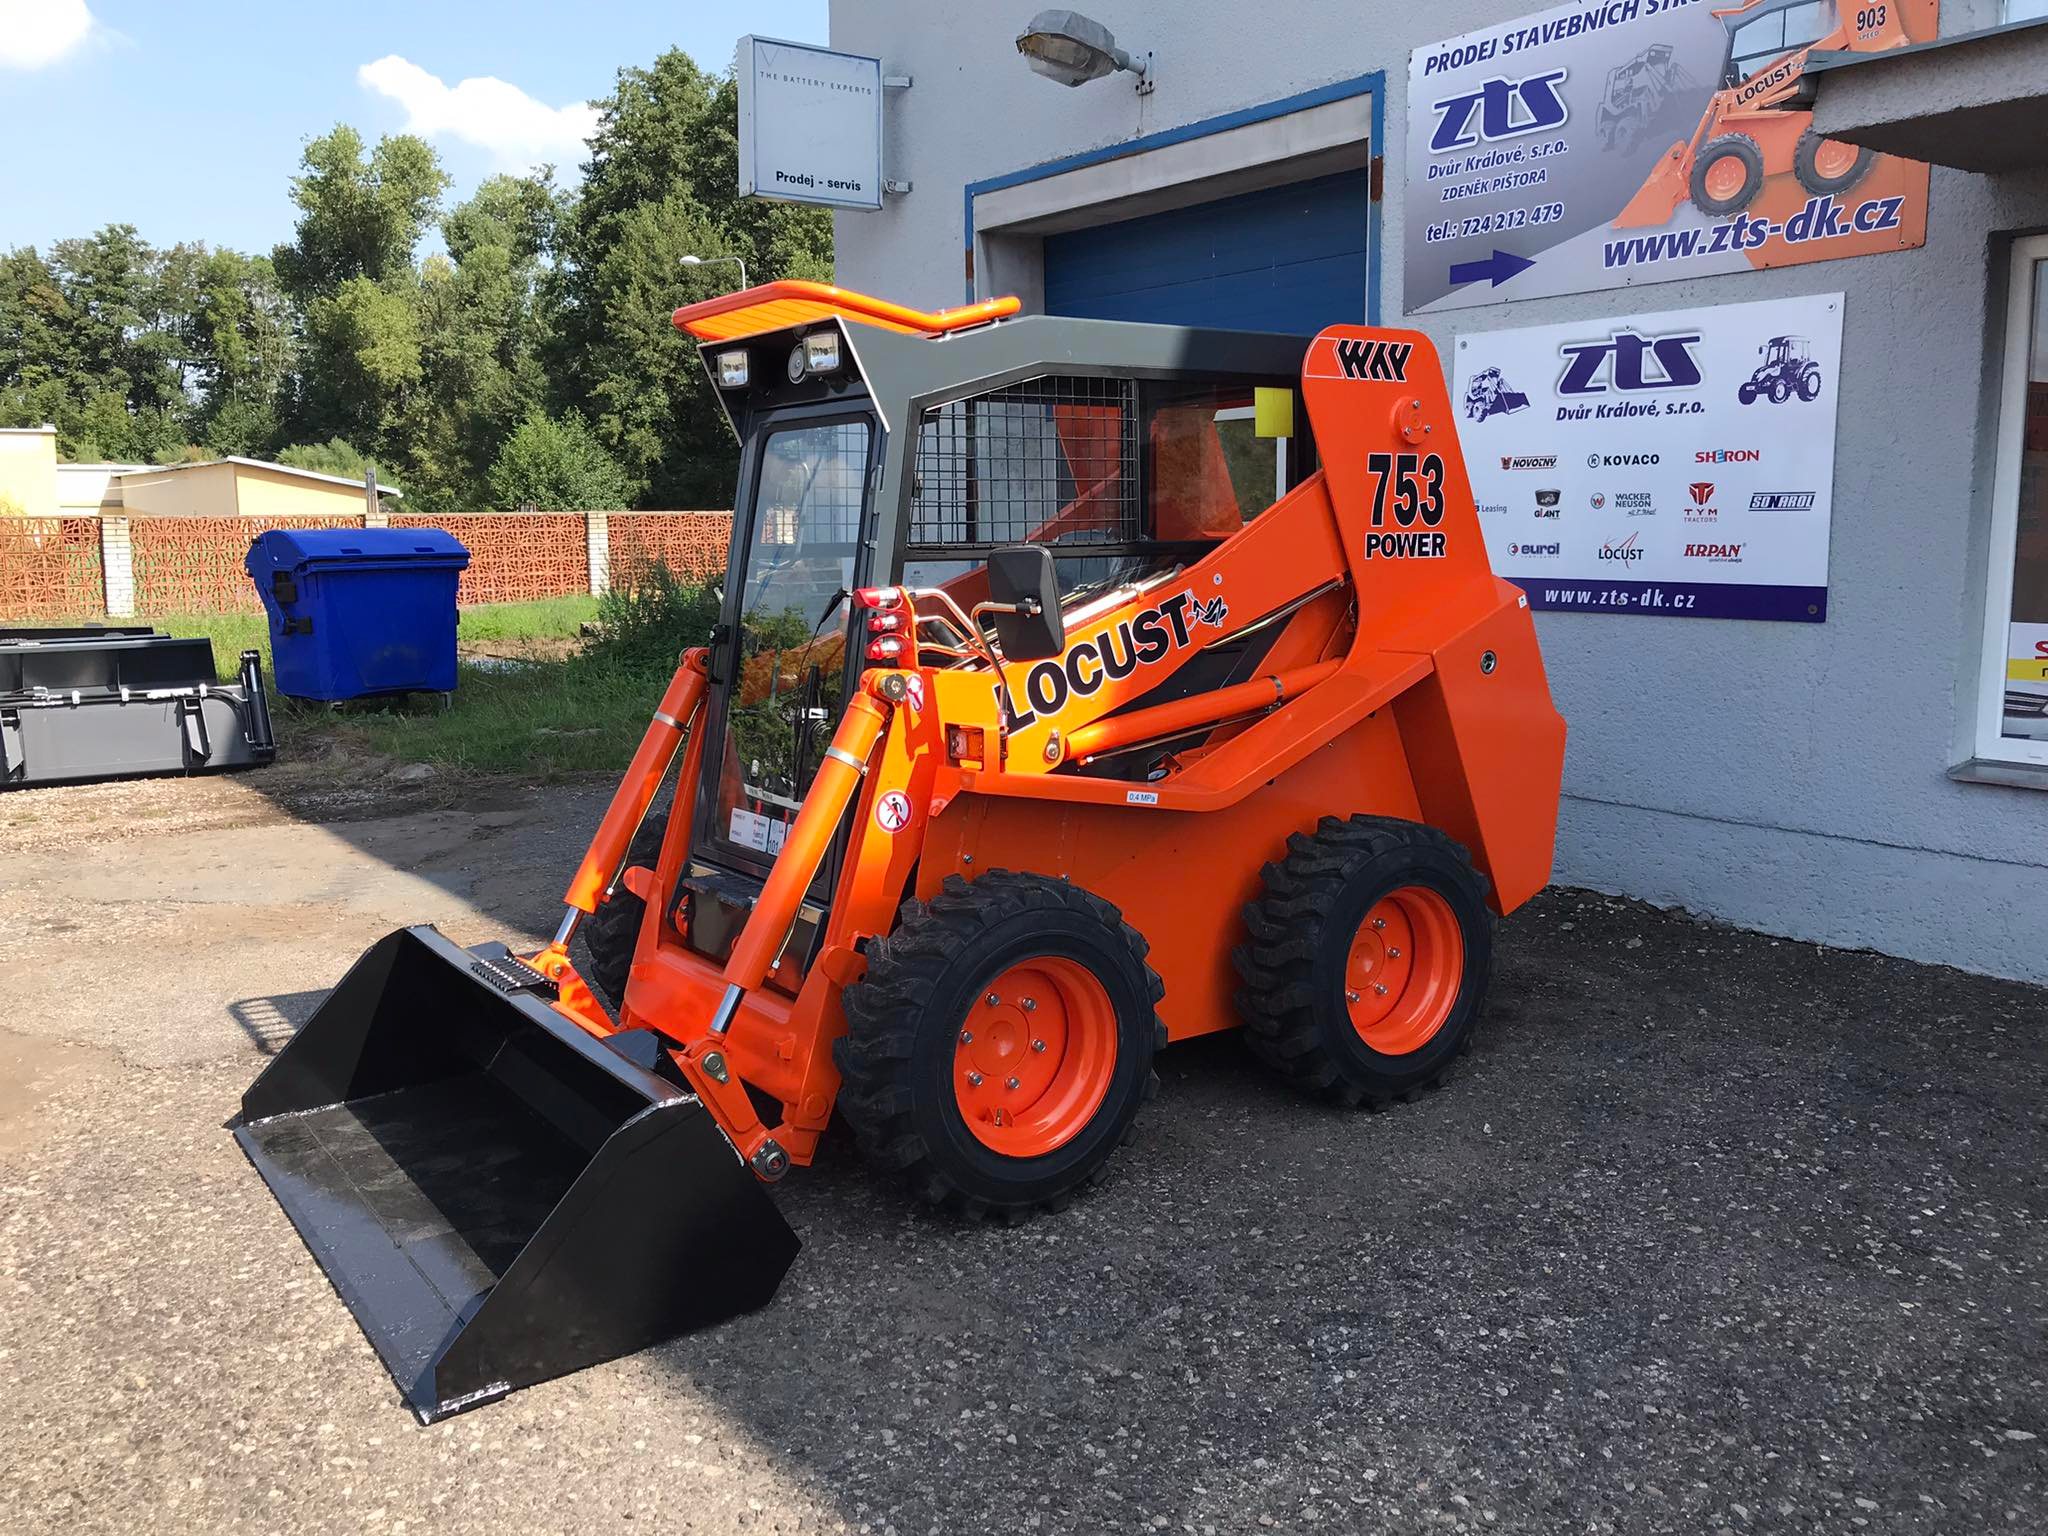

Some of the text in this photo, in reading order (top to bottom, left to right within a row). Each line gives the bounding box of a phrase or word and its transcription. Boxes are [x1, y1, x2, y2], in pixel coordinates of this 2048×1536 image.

[1857, 6, 1886, 31] 903
[1424, 0, 1638, 76] PRODEJ STAVEBNÍCH
[760, 71, 871, 95] THE BATTERY EXPERTS
[1736, 62, 1793, 105] LOCUST
[1428, 141, 1568, 179] Dvůr Králové, s.r.o.
[776, 170, 814, 188] Prodej
[827, 178, 862, 192] servis
[1442, 169, 1546, 201] ZDENĚK PIŠTORA
[1427, 203, 1563, 241] tel.: 724 212 479
[1604, 196, 1904, 268] www.zts-dk.cz
[1337, 339, 1412, 382] WAY
[1556, 400, 1705, 421] Dvůr Králové, s.r.o.
[1603, 454, 1660, 466] KOVACO
[1695, 449, 1760, 464] SHERON
[1367, 453, 1445, 528] 753
[1615, 492, 1651, 500] WACKER
[1481, 504, 1507, 514] Leasing
[1615, 500, 1651, 508] NEUSON
[1365, 532, 1446, 559] POWER
[1599, 549, 1644, 561] LOCUST
[1683, 544, 1742, 558] KRPAN
[1545, 588, 1696, 608] www.zts-dk.cz
[993, 592, 1190, 736] LOCUST
